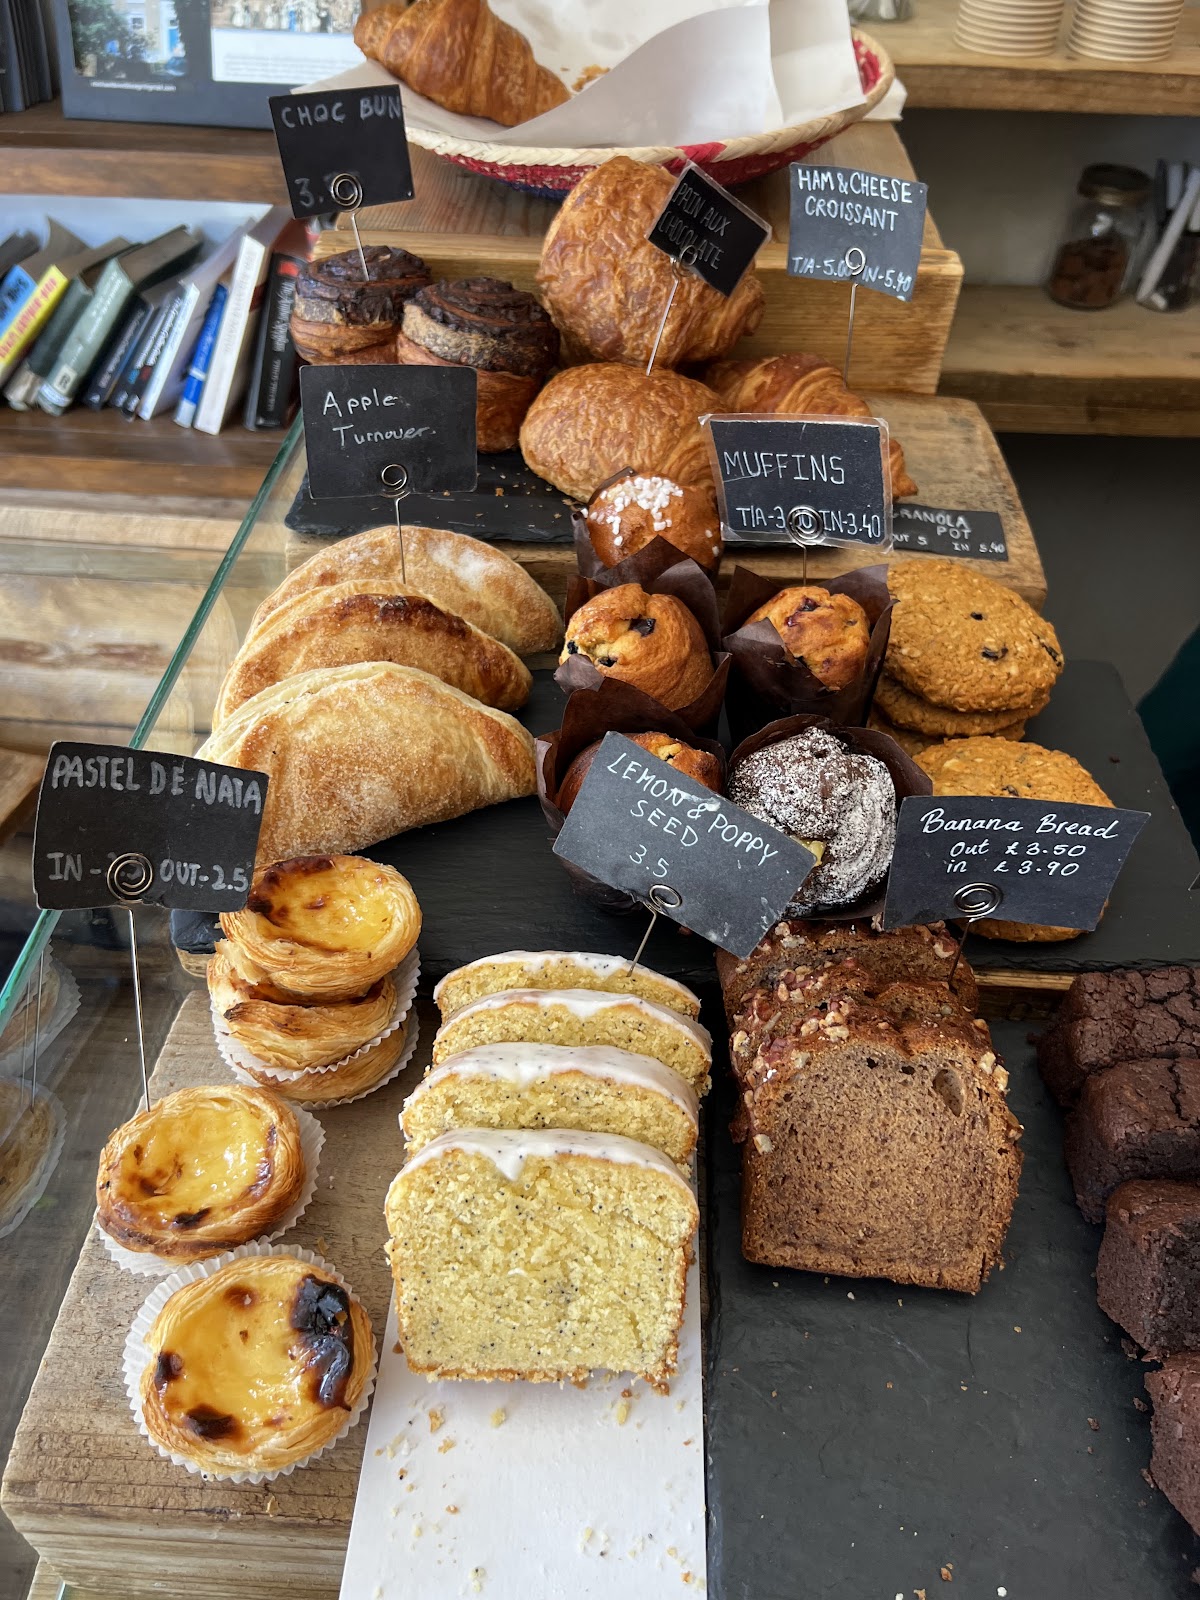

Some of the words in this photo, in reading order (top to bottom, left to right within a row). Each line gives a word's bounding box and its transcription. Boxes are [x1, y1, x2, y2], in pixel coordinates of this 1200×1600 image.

[281, 102, 346, 128] CHOC
[360, 95, 400, 120] BUN
[672, 182, 707, 218] PAIN
[700, 207, 731, 237] AUX
[805, 195, 898, 231] CROISSANT
[323, 388, 398, 417] Apple
[333, 424, 430, 447] Turnover
[723, 451, 845, 484] MUFFINS
[937, 526, 971, 540] POT
[952, 541, 970, 551] IN
[51, 754, 140, 790] PASTEL
[150, 761, 185, 796] DE
[195, 768, 262, 814] NATA
[607, 752, 685, 807] LEMON
[687, 802, 708, 820] &
[708, 813, 778, 866] POPPY
[630, 799, 698, 847] SEED
[920, 807, 1023, 833] Banana
[1036, 813, 1119, 840] Bread
[629, 844, 670, 878] 3.5
